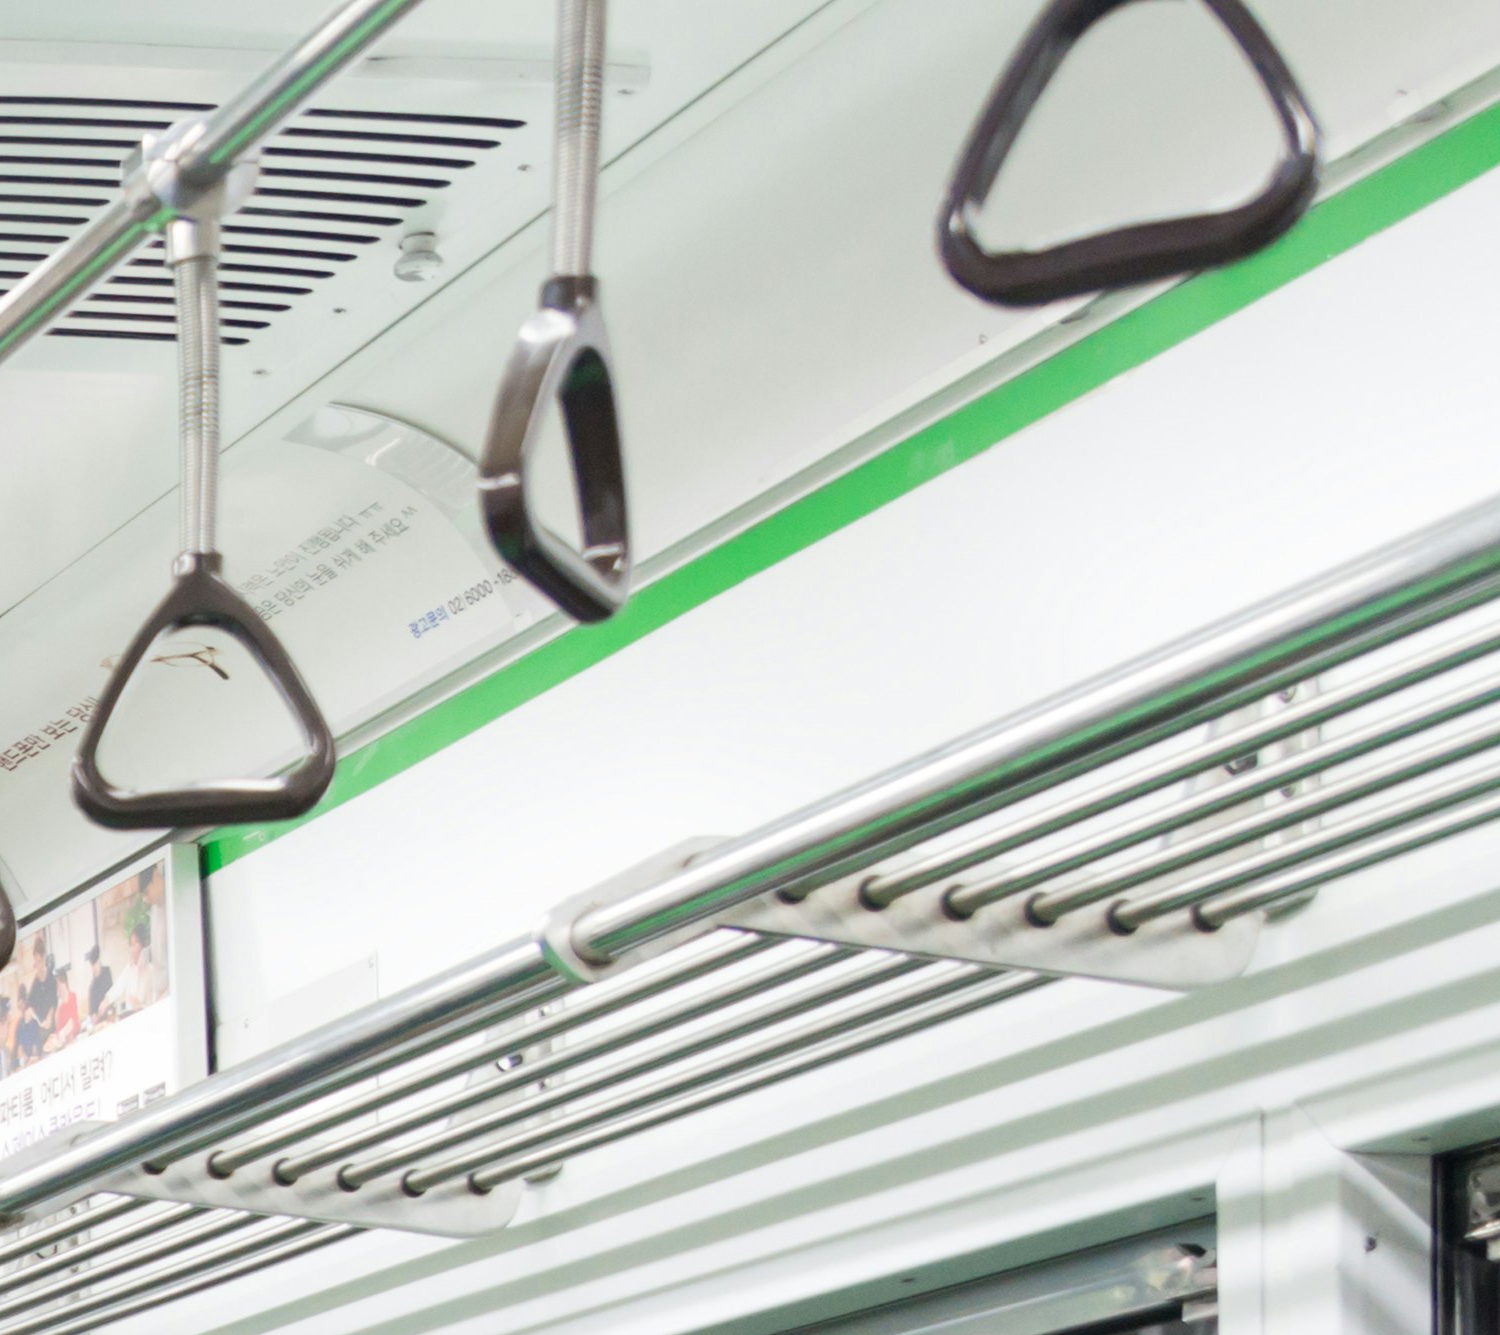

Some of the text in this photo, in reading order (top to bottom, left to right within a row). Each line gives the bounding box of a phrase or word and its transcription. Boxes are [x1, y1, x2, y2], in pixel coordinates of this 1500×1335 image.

[368, 518, 411, 546] 주세요
[41, 719, 79, 741] 보는
[40, 1070, 76, 1105] 어디서
[79, 1050, 114, 1091] 빌려?
